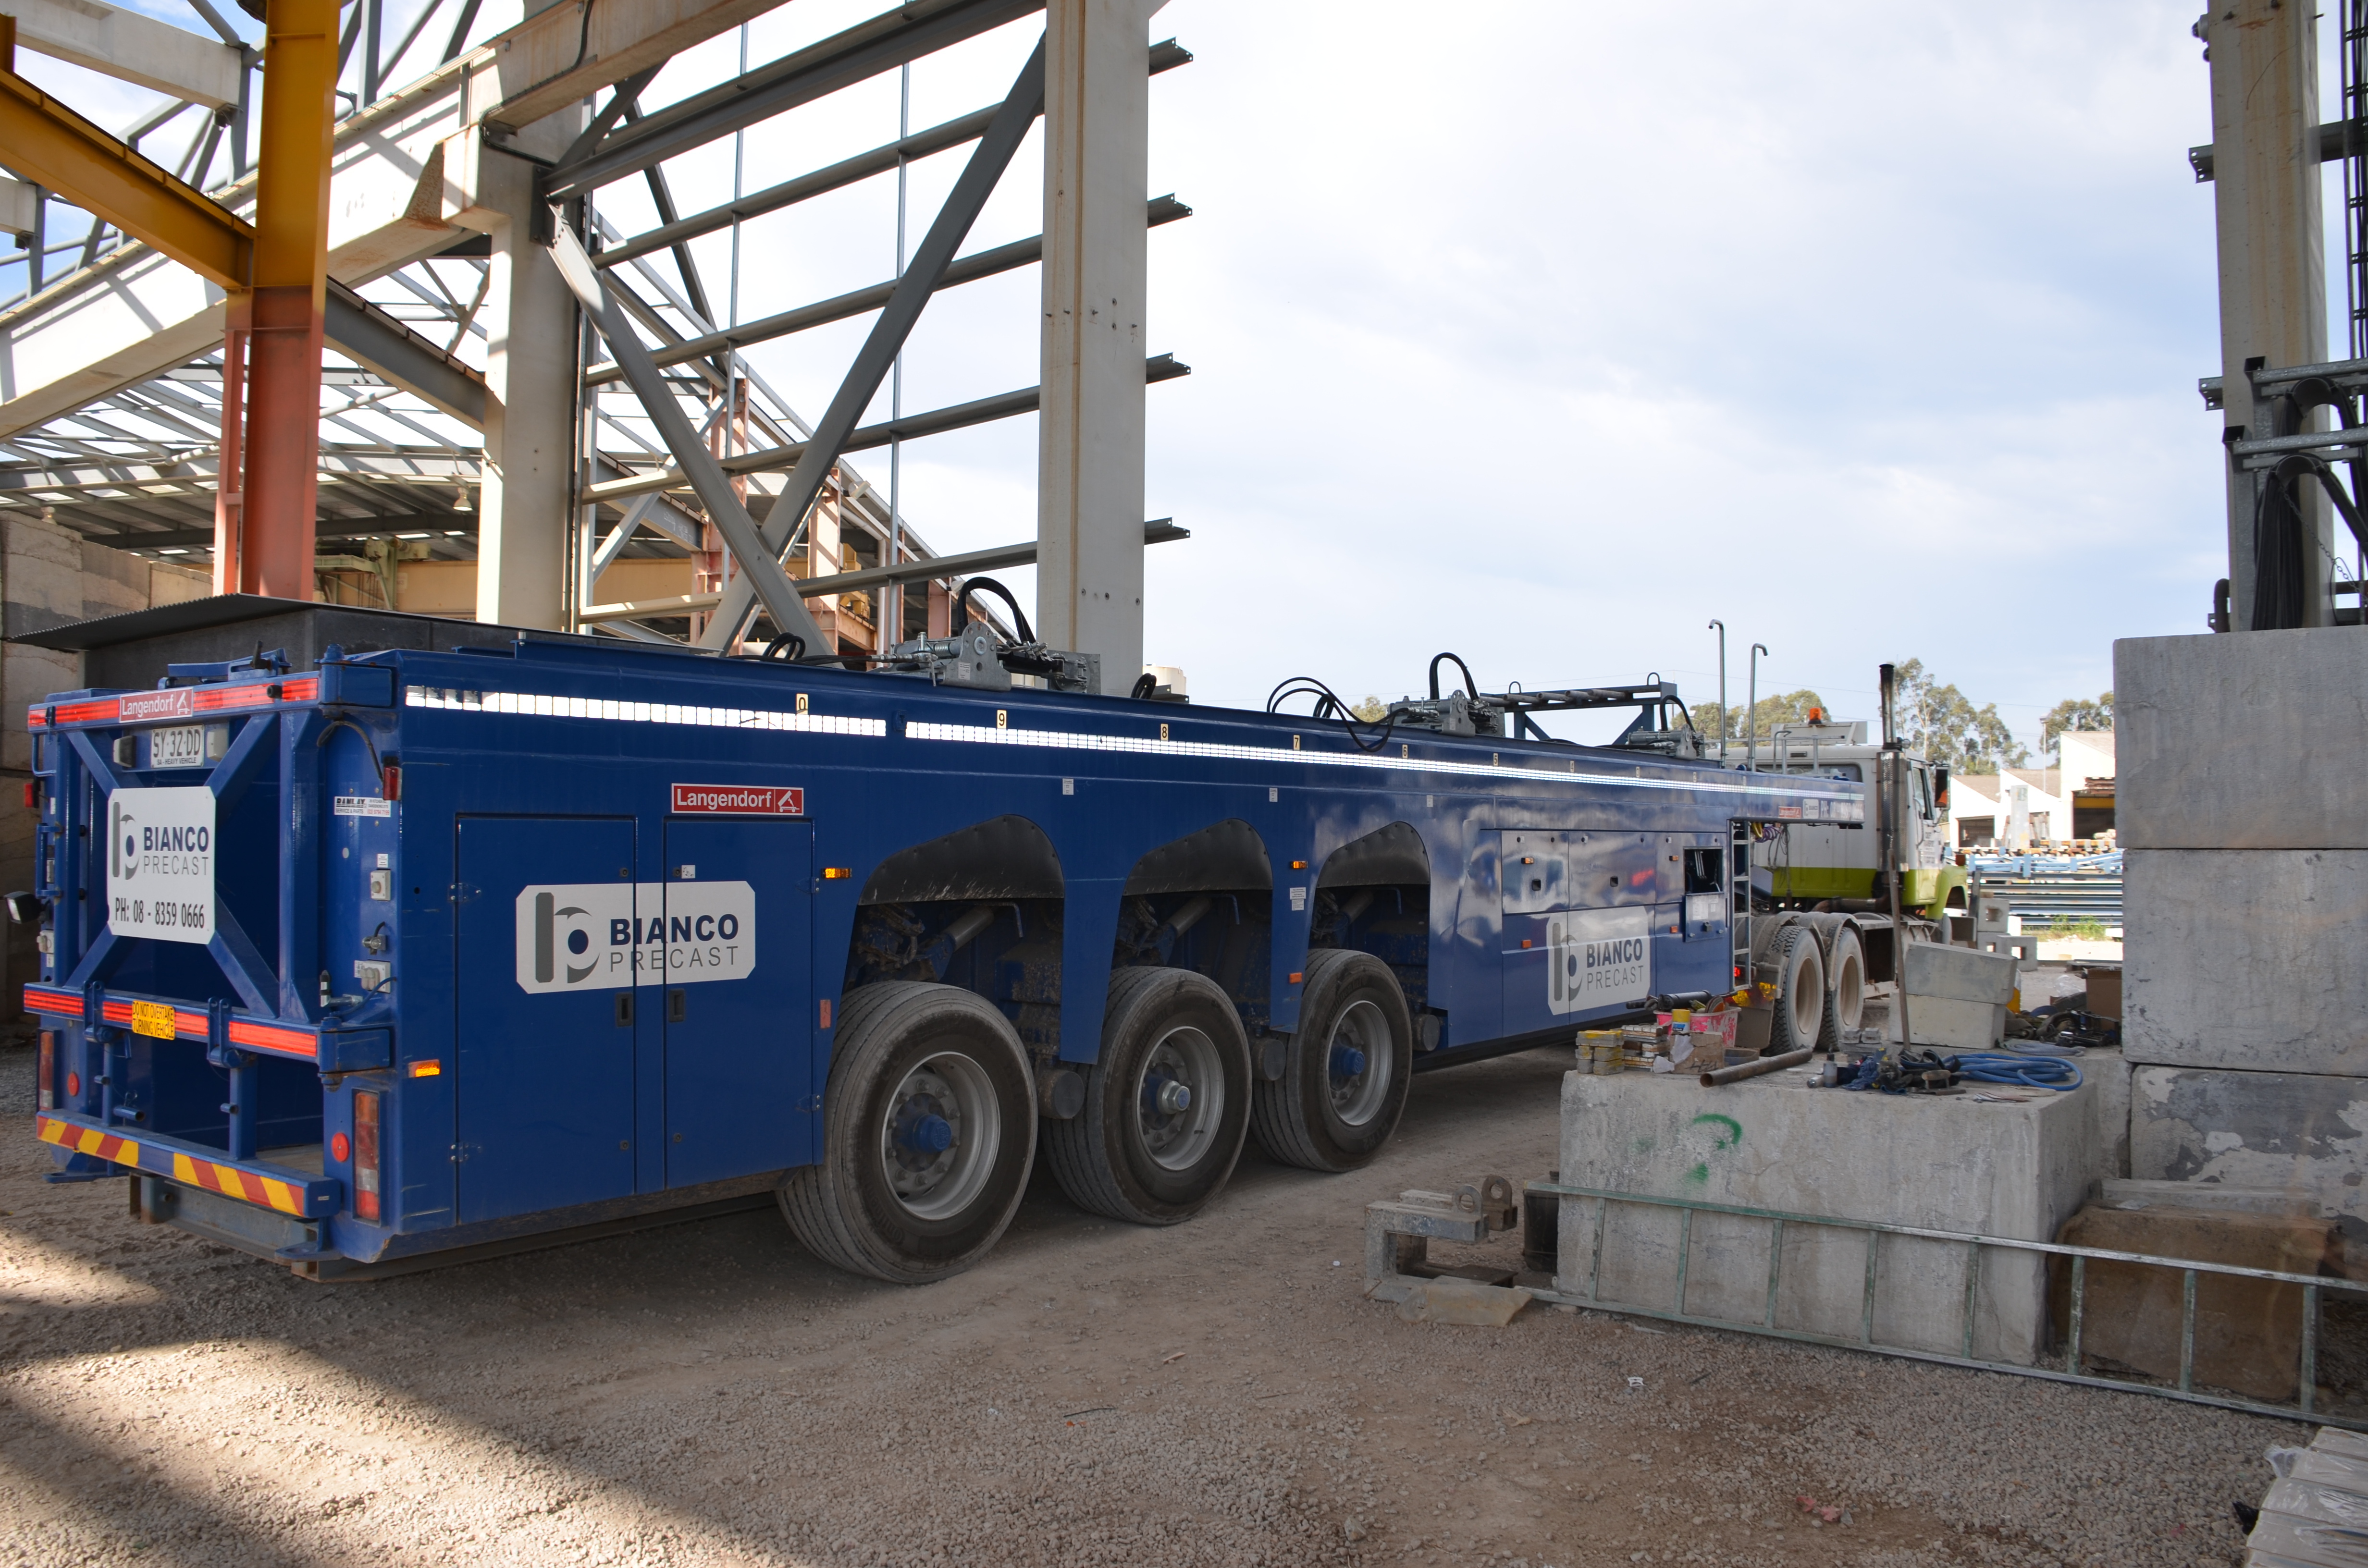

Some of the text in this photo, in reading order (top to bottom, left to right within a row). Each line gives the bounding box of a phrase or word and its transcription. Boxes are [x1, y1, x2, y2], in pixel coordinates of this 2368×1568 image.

[122, 694, 174, 718] Langendorf
[999, 713, 1005, 726] 9
[1162, 726, 1167, 738] 8
[1294, 737, 1299, 748] 7
[1403, 746, 1407, 757] 6
[1494, 755, 1498, 765] 5
[677, 788, 772, 810] Langendorf
[143, 826, 210, 852] BIANCO
[143, 855, 209, 876] PRECAST
[115, 897, 130, 922] PH:
[133, 899, 144, 923] 08
[155, 901, 177, 927] 8359
[181, 903, 205, 929] 0666
[610, 914, 739, 946] BIANCO
[610, 946, 739, 972] PRECAST
[1587, 938, 1643, 968] BIANCO
[1587, 965, 1644, 991] PRECAST
[133, 1002, 173, 1022] DO NOT OVERTAKE
[133, 1017, 174, 1038] TURNING VEHICLE
